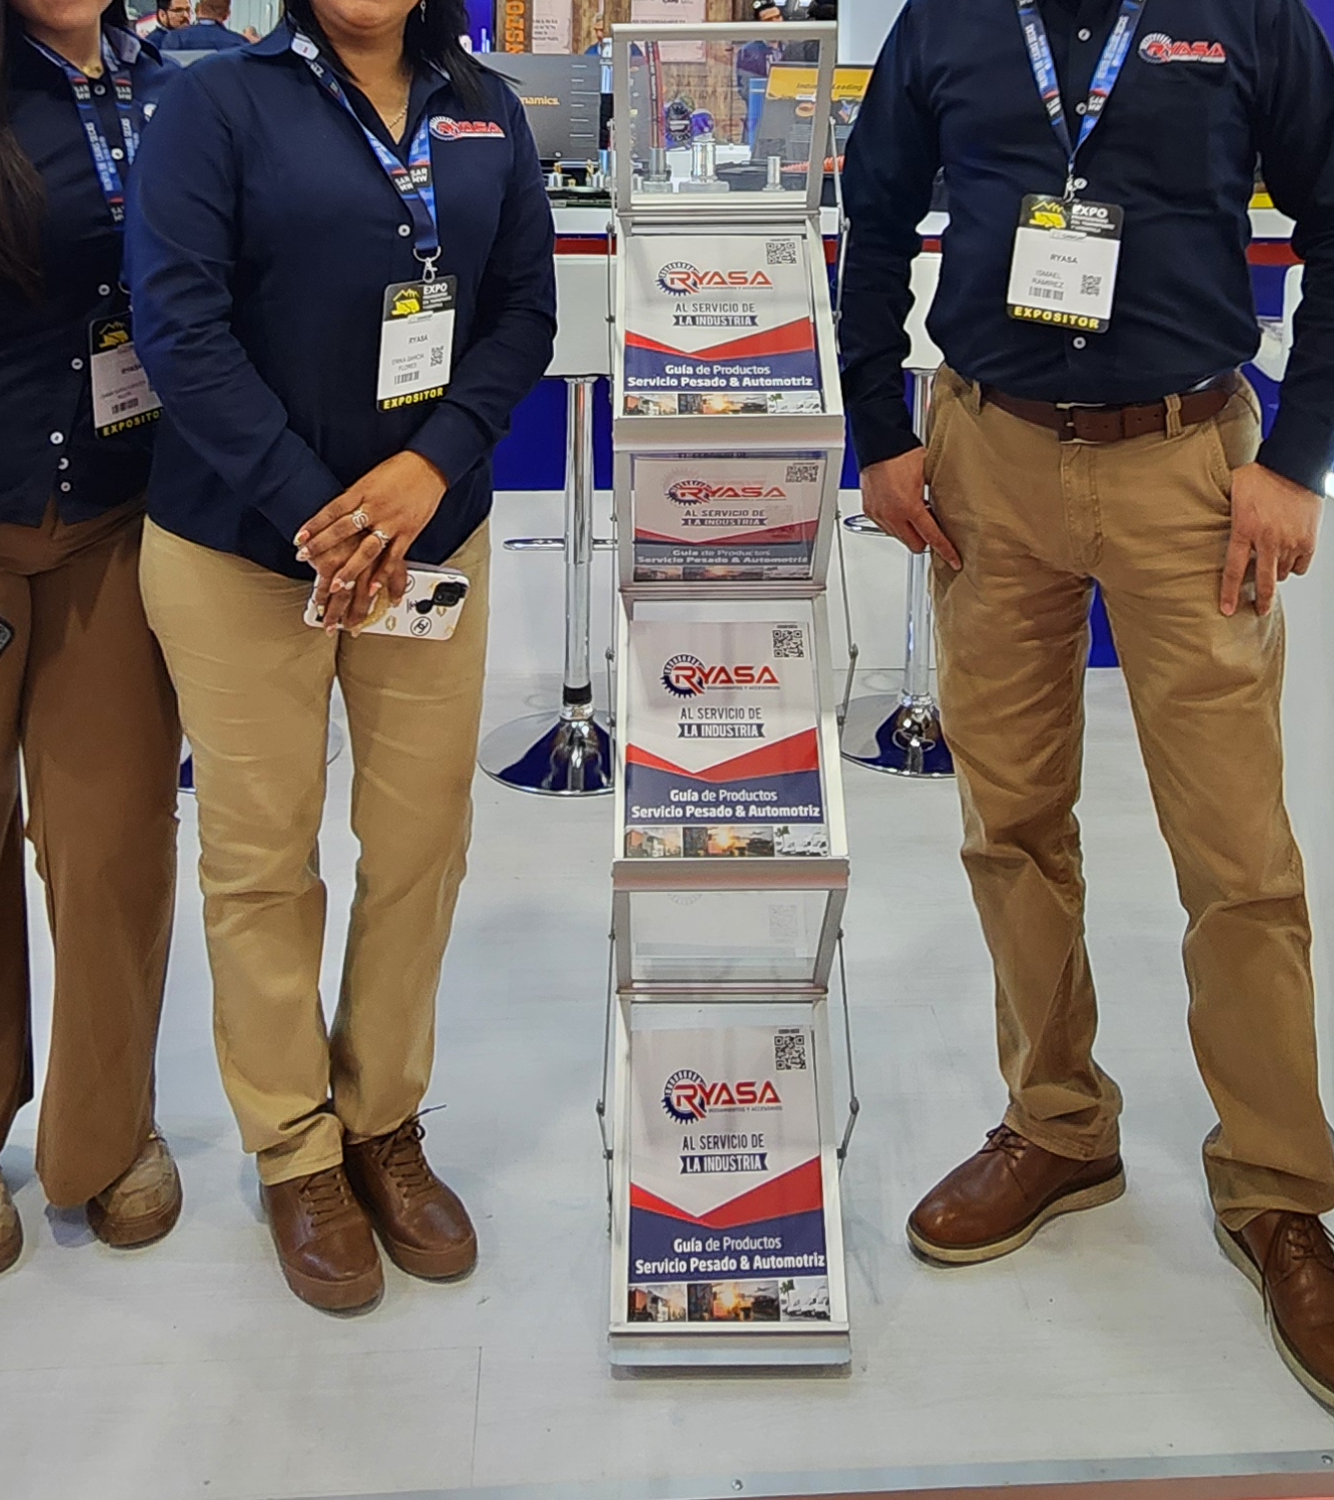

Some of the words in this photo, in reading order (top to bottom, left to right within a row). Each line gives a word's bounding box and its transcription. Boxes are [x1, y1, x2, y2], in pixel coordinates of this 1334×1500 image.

[1072, 204, 1108, 218] EXPO
[1050, 254, 1078, 264] RYASA
[423, 282, 448, 295] EXPO
[669, 271, 773, 294] RYASA
[675, 303, 688, 313] AL
[692, 303, 737, 313] SERVICIO
[742, 303, 755, 313] DE
[679, 316, 693, 326] LA
[696, 316, 752, 326] INDUSTRIA
[1014, 306, 1100, 329] EXPOSITOR
[696, 365, 710, 375] de
[713, 365, 770, 375] Productos
[628, 377, 678, 387] Servicio
[681, 377, 726, 387] Pesado
[729, 378, 739, 387] &
[742, 377, 813, 387] Automotriz
[383, 386, 444, 410] EXPOSITOR
[103, 410, 163, 437] EXPOSITO
[673, 666, 780, 694] RYASA
[680, 708, 694, 719] AL
[697, 708, 745, 719] SERVICIO
[748, 708, 762, 719] DE
[684, 725, 698, 737] LA
[701, 725, 759, 737] INDUSTRIA
[701, 790, 716, 801] de
[719, 790, 777, 801] Productos
[631, 806, 683, 818] Servicio
[686, 806, 732, 818] Pesado
[735, 806, 745, 817] &
[748, 805, 820, 817] Automotriz
[674, 1080, 781, 1119] RYASA
[682, 1136, 695, 1150] AL
[700, 1135, 747, 1150] SERVICIO
[751, 1133, 764, 1147] DE
[686, 1157, 700, 1172] LA
[703, 1155, 762, 1171] INDUSTRIA
[674, 1238, 702, 1253] Guía
[706, 1238, 720, 1251] de
[723, 1236, 782, 1251] Productos
[635, 1258, 687, 1274] Servicio
[690, 1257, 737, 1272] Pesado
[740, 1257, 750, 1270] &
[753, 1254, 825, 1270] Automotriz
